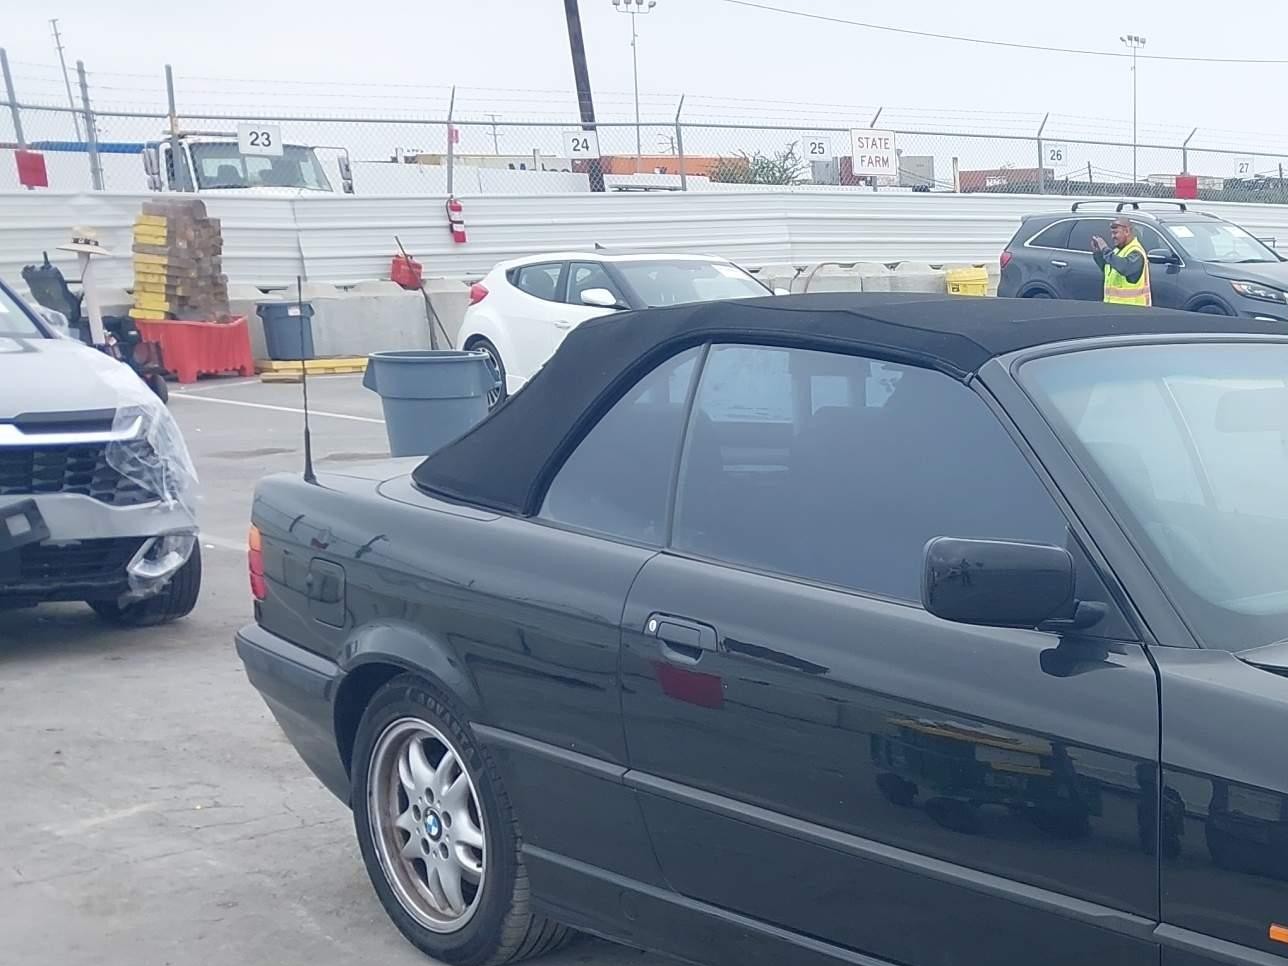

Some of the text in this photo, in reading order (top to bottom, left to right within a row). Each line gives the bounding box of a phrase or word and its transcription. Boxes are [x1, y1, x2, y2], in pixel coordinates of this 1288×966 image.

[249, 130, 272, 147] 23
[571, 137, 590, 152] 24
[857, 136, 890, 150] STATE
[809, 142, 825, 155] 25
[1049, 149, 1063, 161] 26
[860, 155, 890, 169] FARM
[1239, 162, 1249, 173] 27
